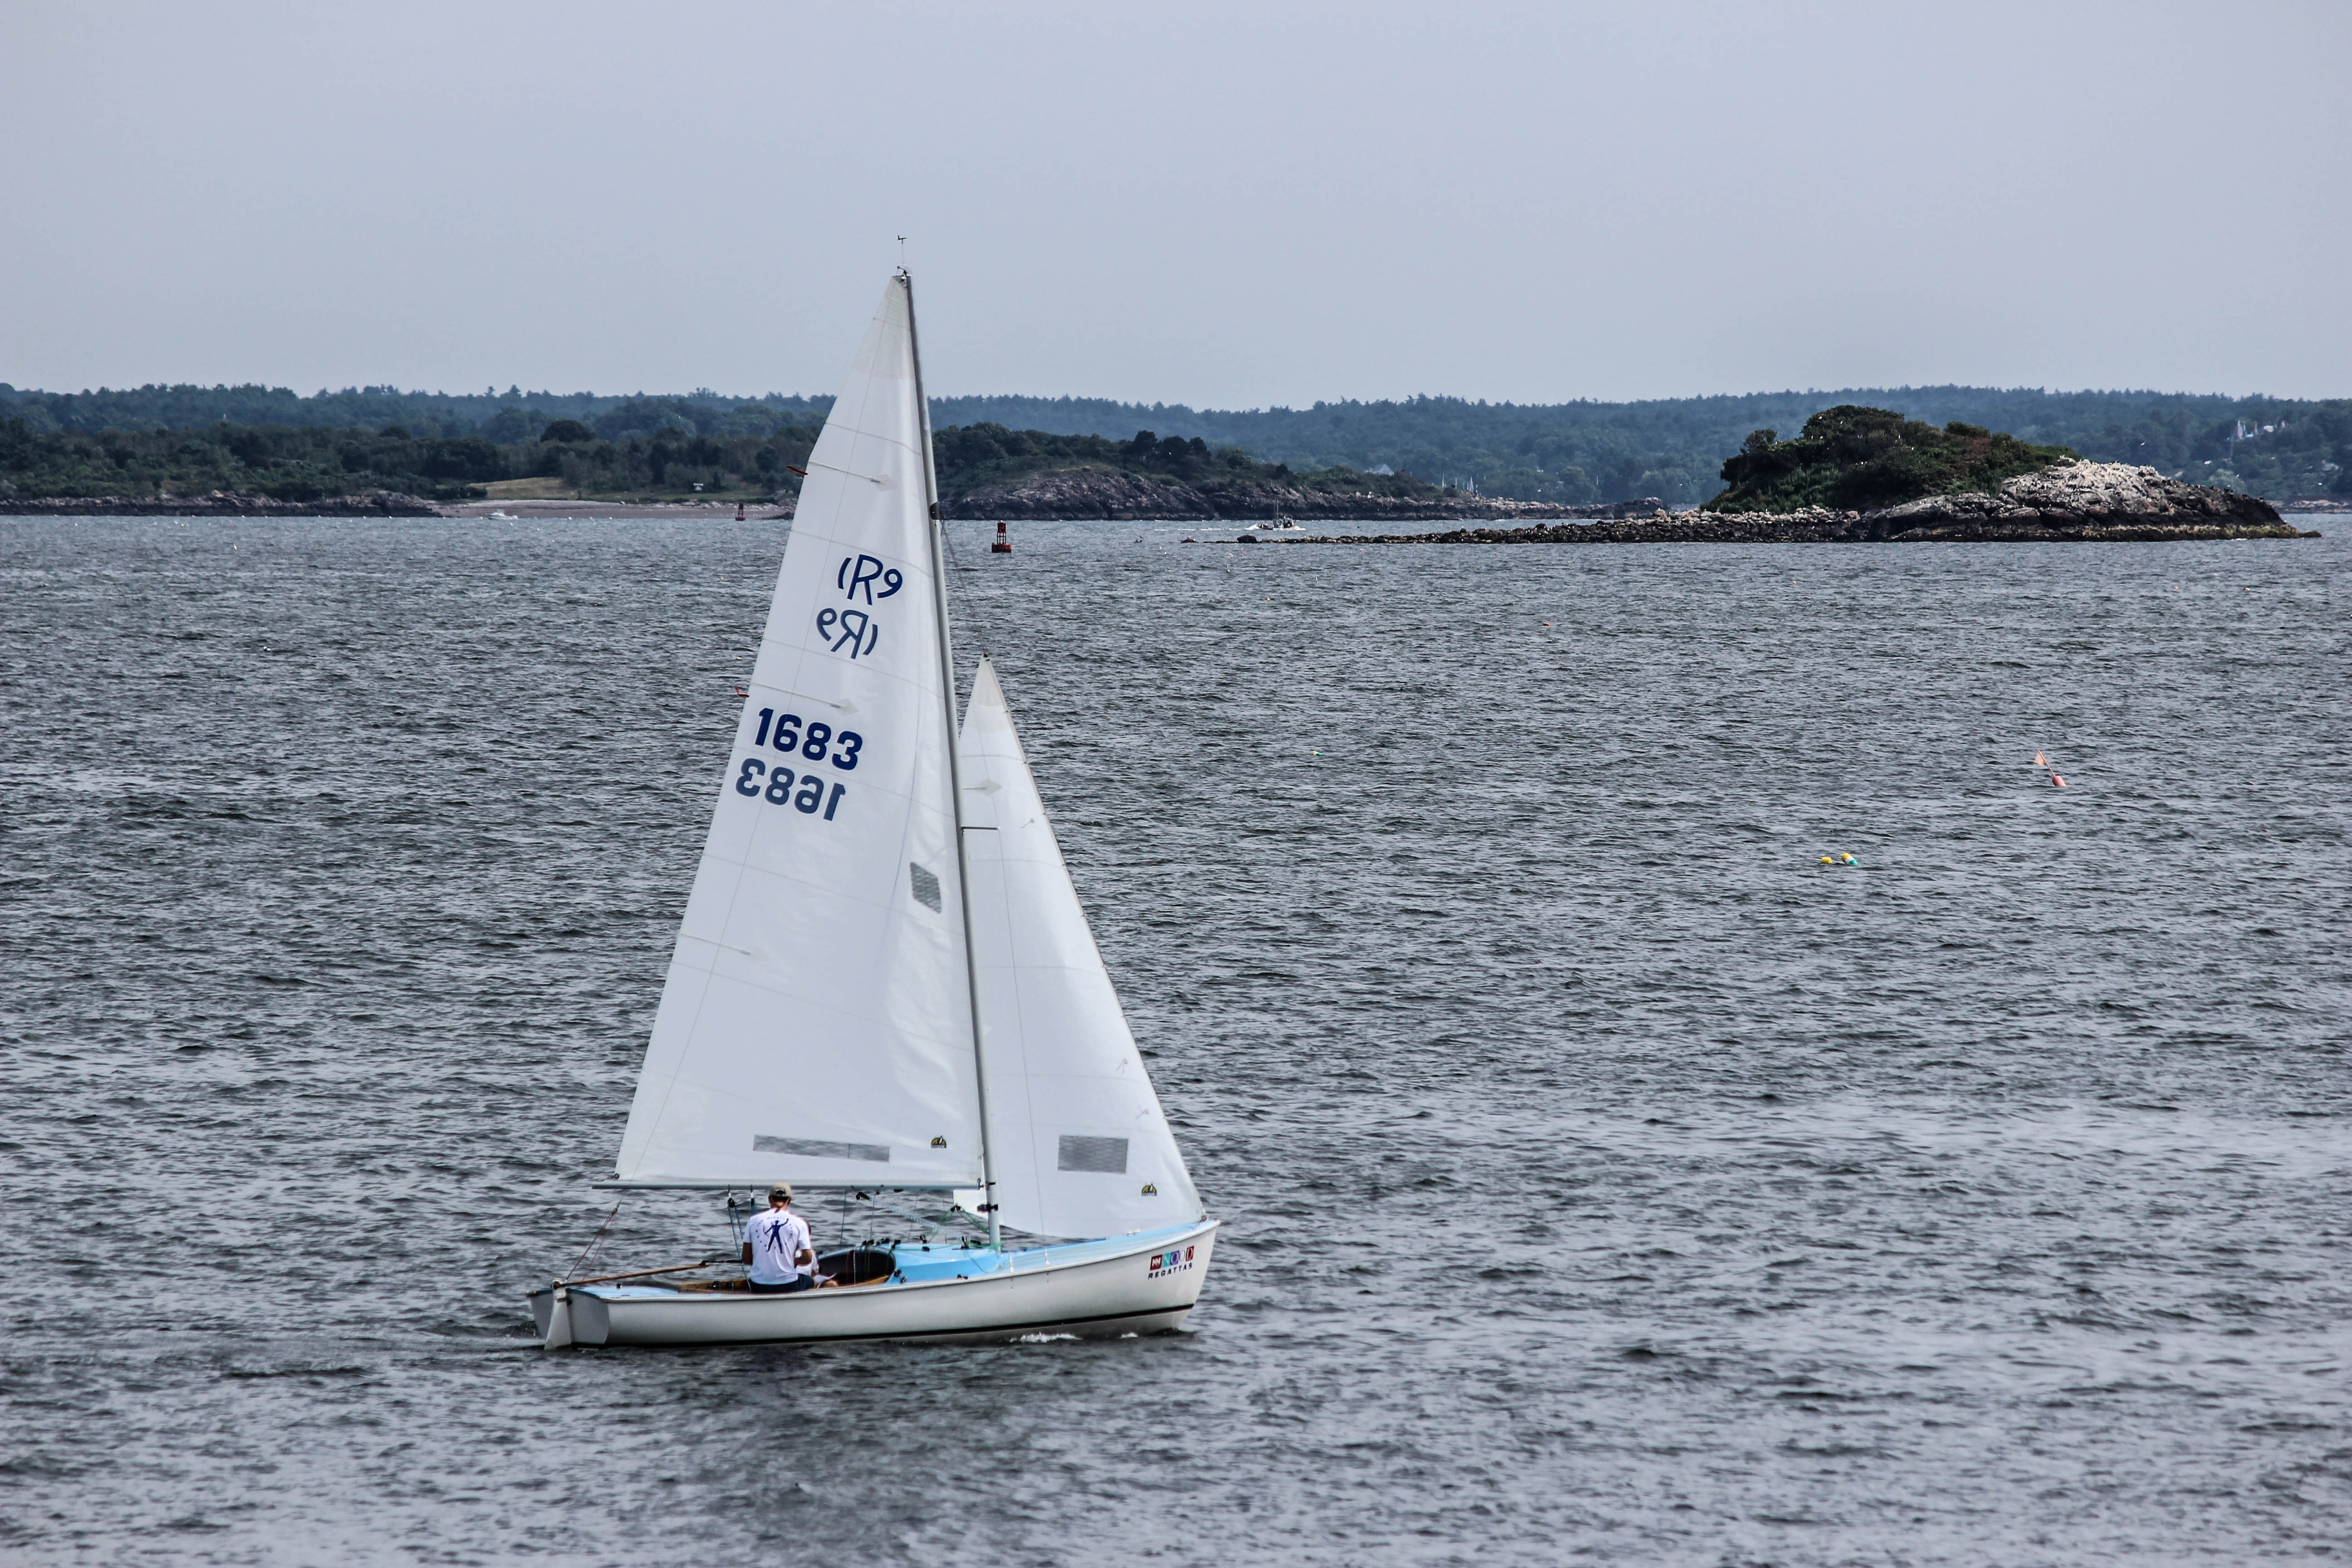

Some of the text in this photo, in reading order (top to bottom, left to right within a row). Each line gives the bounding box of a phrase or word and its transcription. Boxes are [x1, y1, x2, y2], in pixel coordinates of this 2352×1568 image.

[755, 708, 862, 770] 1683
[1162, 1246, 1194, 1267] NOOD
[1148, 1262, 1193, 1279] REGATTAS
